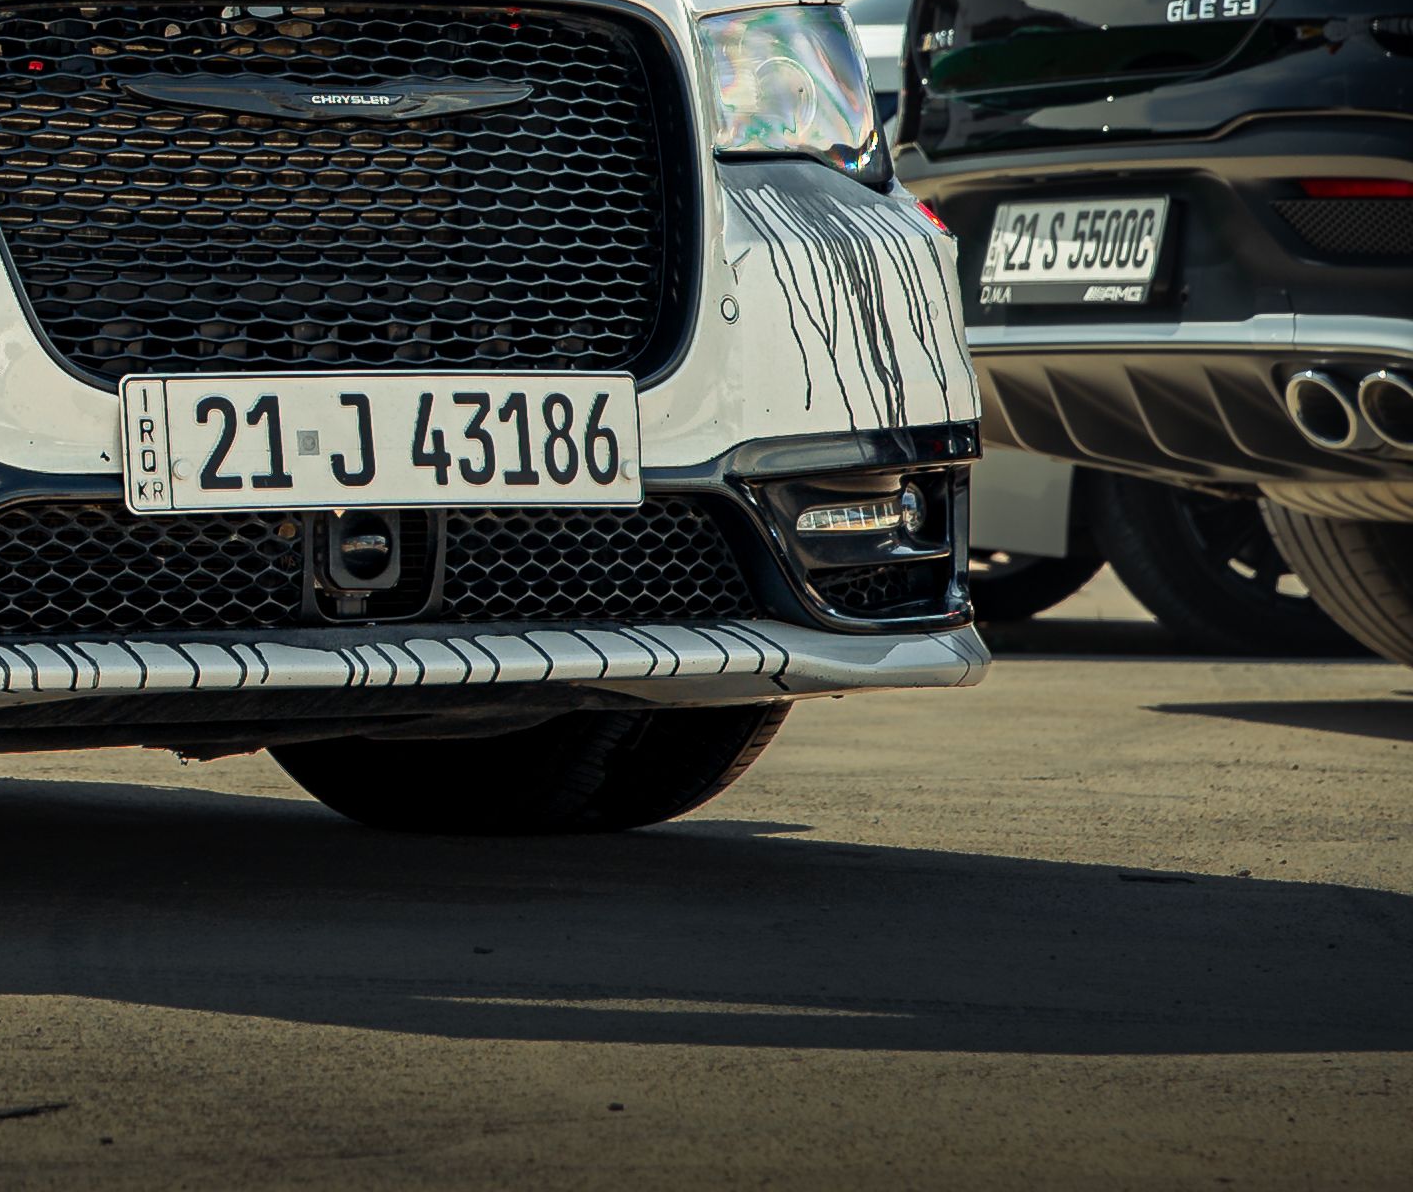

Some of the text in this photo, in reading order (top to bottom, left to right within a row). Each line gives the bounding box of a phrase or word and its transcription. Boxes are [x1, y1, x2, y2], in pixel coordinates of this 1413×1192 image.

[311, 95, 390, 105] CHRYSLER
[1004, 213, 1040, 270] 21
[1043, 212, 1065, 269] S
[194, 391, 620, 490] 21 J 43186
[136, 481, 165, 503] KR
